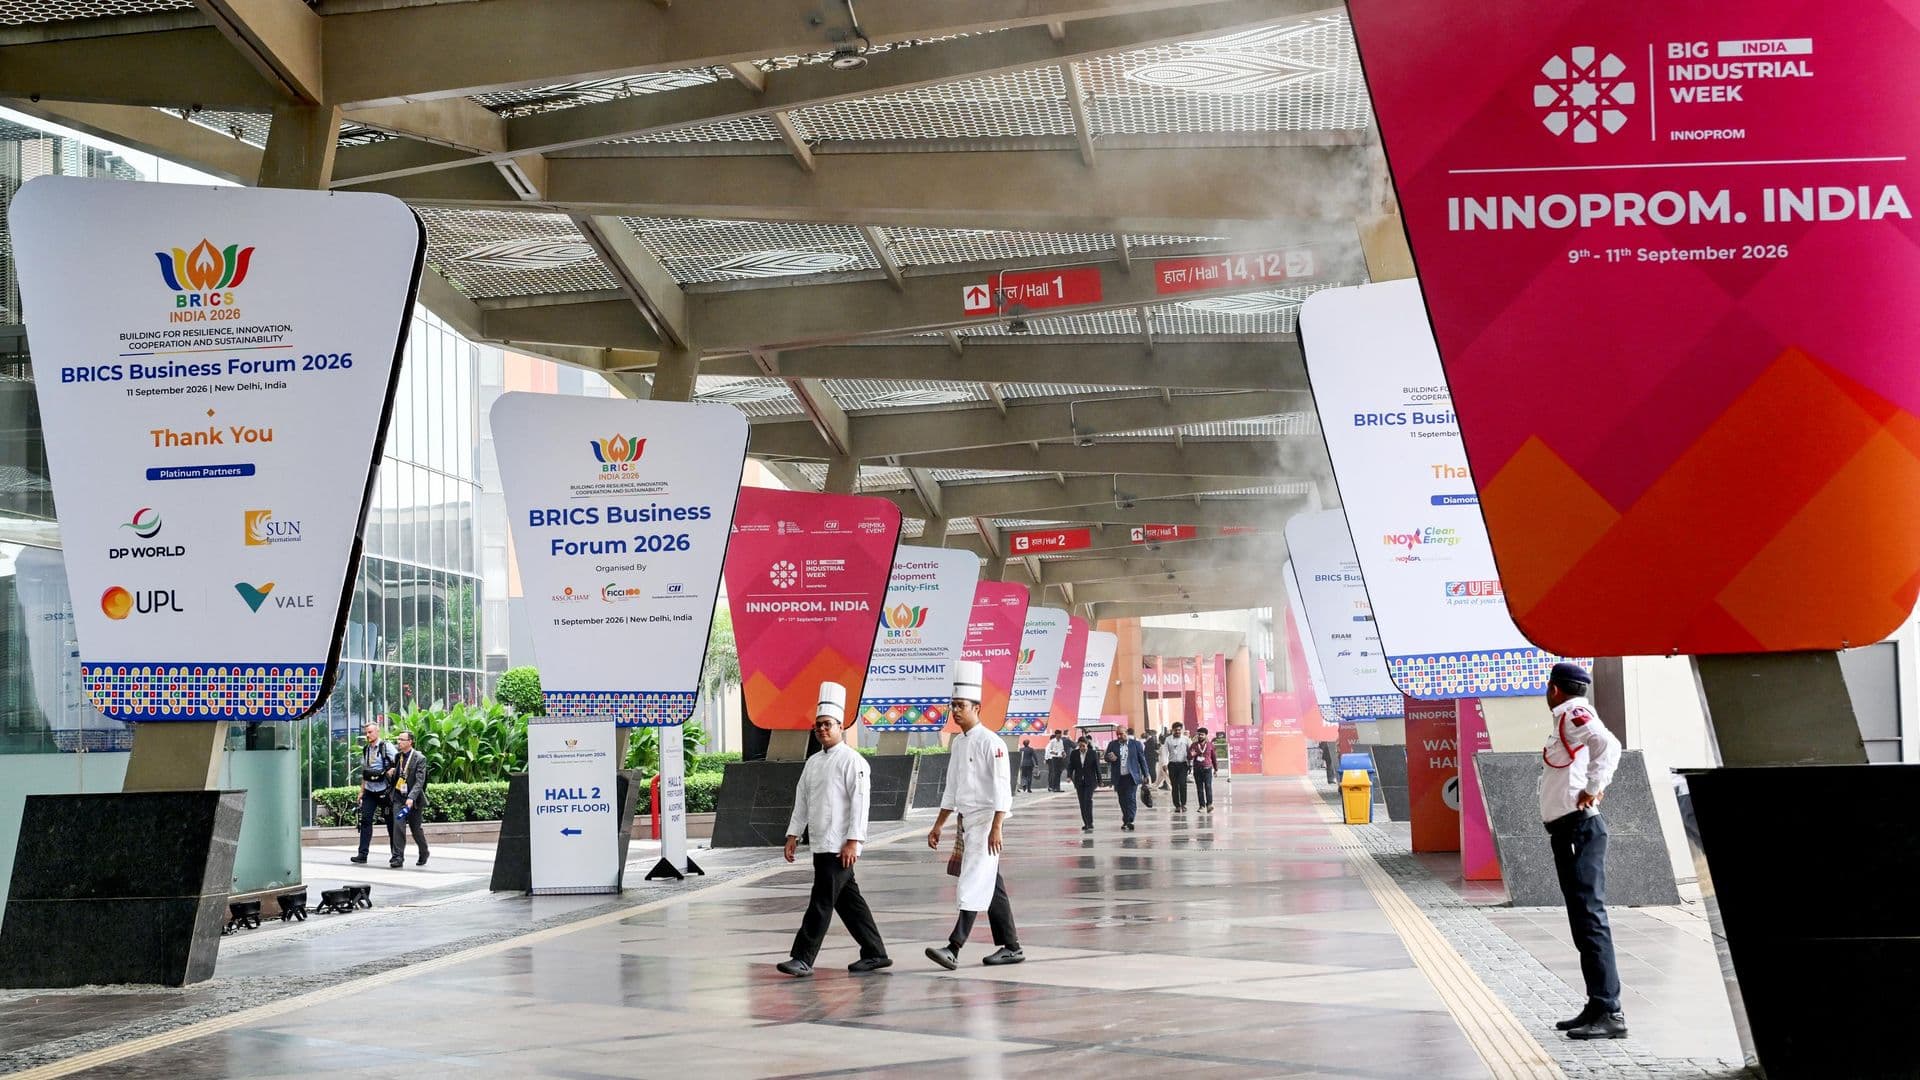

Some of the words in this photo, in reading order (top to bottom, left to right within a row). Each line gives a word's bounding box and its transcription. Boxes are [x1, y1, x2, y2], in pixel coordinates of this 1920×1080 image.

[1668, 42, 1708, 58] BIG
[1742, 41, 1788, 53] INDIA
[1668, 61, 1813, 80] INDUSTRIAL
[1670, 86, 1743, 104] WEEK
[1670, 129, 1745, 140] INNOPROM
[1448, 190, 1746, 231] INNOPROM.
[1763, 185, 1912, 222] INDIA
[1568, 248, 1590, 264] 9th
[1606, 248, 1632, 262] 11th
[1637, 246, 1736, 265] September
[1742, 244, 1789, 259] 2026
[1164, 270, 1186, 284] हाल
[1195, 265, 1218, 280] Hall
[1026, 283, 1048, 297] Hall
[1053, 276, 1063, 298] 1
[176, 292, 234, 308] BRICS
[170, 310, 206, 323] INDIA
[210, 308, 241, 321] 2026
[120, 331, 162, 341] BUILDING
[163, 330, 180, 340] FOR
[182, 327, 234, 339] RESILIENCE,
[236, 324, 293, 336] INNOVATION,
[128, 339, 191, 350] COOPERATION
[193, 338, 212, 347] AND
[214, 334, 284, 347] SUSTAINABILITY
[61, 365, 123, 384] BRICS
[130, 360, 222, 380] Business
[228, 357, 296, 376] Forum
[302, 353, 352, 372] 2026
[126, 389, 134, 397] 11
[135, 386, 185, 399] September
[186, 385, 208, 394] 2026
[215, 383, 234, 392] New
[236, 381, 262, 392] Delhi,
[264, 380, 286, 390] India
[1354, 413, 1407, 426] BRICS
[150, 426, 223, 448] Thank
[229, 424, 273, 444] You
[1418, 430, 1460, 439] September
[160, 469, 200, 478] Platinum
[202, 466, 241, 476] Partners
[602, 464, 636, 472] BRICS
[1432, 464, 1467, 478] Tha
[622, 472, 640, 480] 2026
[529, 508, 599, 526] BRICS
[607, 503, 711, 524] Business
[266, 520, 301, 536] SUN
[1173, 525, 1178, 536] 1
[1424, 527, 1455, 535] Clean
[266, 535, 302, 544] International
[551, 538, 626, 556] Forum
[634, 534, 690, 553] 2026
[1046, 537, 1056, 545] Hall
[1059, 535, 1065, 545] 2
[1423, 536, 1462, 546] Energy
[110, 548, 129, 560] DP
[132, 546, 185, 558] WORLD
[596, 564, 634, 573] Organised
[636, 564, 646, 572] By
[893, 561, 939, 569] le-Centric
[1469, 582, 1503, 595] UFL
[136, 590, 184, 614] UPL
[275, 596, 314, 610] VALE
[746, 602, 826, 613] INNOPROM.
[830, 600, 870, 611] INDIA
[562, 617, 603, 627] September
[649, 614, 671, 622] Delhi,
[985, 648, 1011, 656] INDIA
[870, 665, 896, 674] RICS
[899, 664, 945, 674] SUMMIT
[1409, 711, 1456, 720] INNOPRO
[1430, 757, 1458, 768] HAL
[545, 788, 587, 800] HALL
[592, 787, 600, 799] 2
[536, 804, 568, 815] (FIRST
[572, 803, 610, 813] FLOOR)
